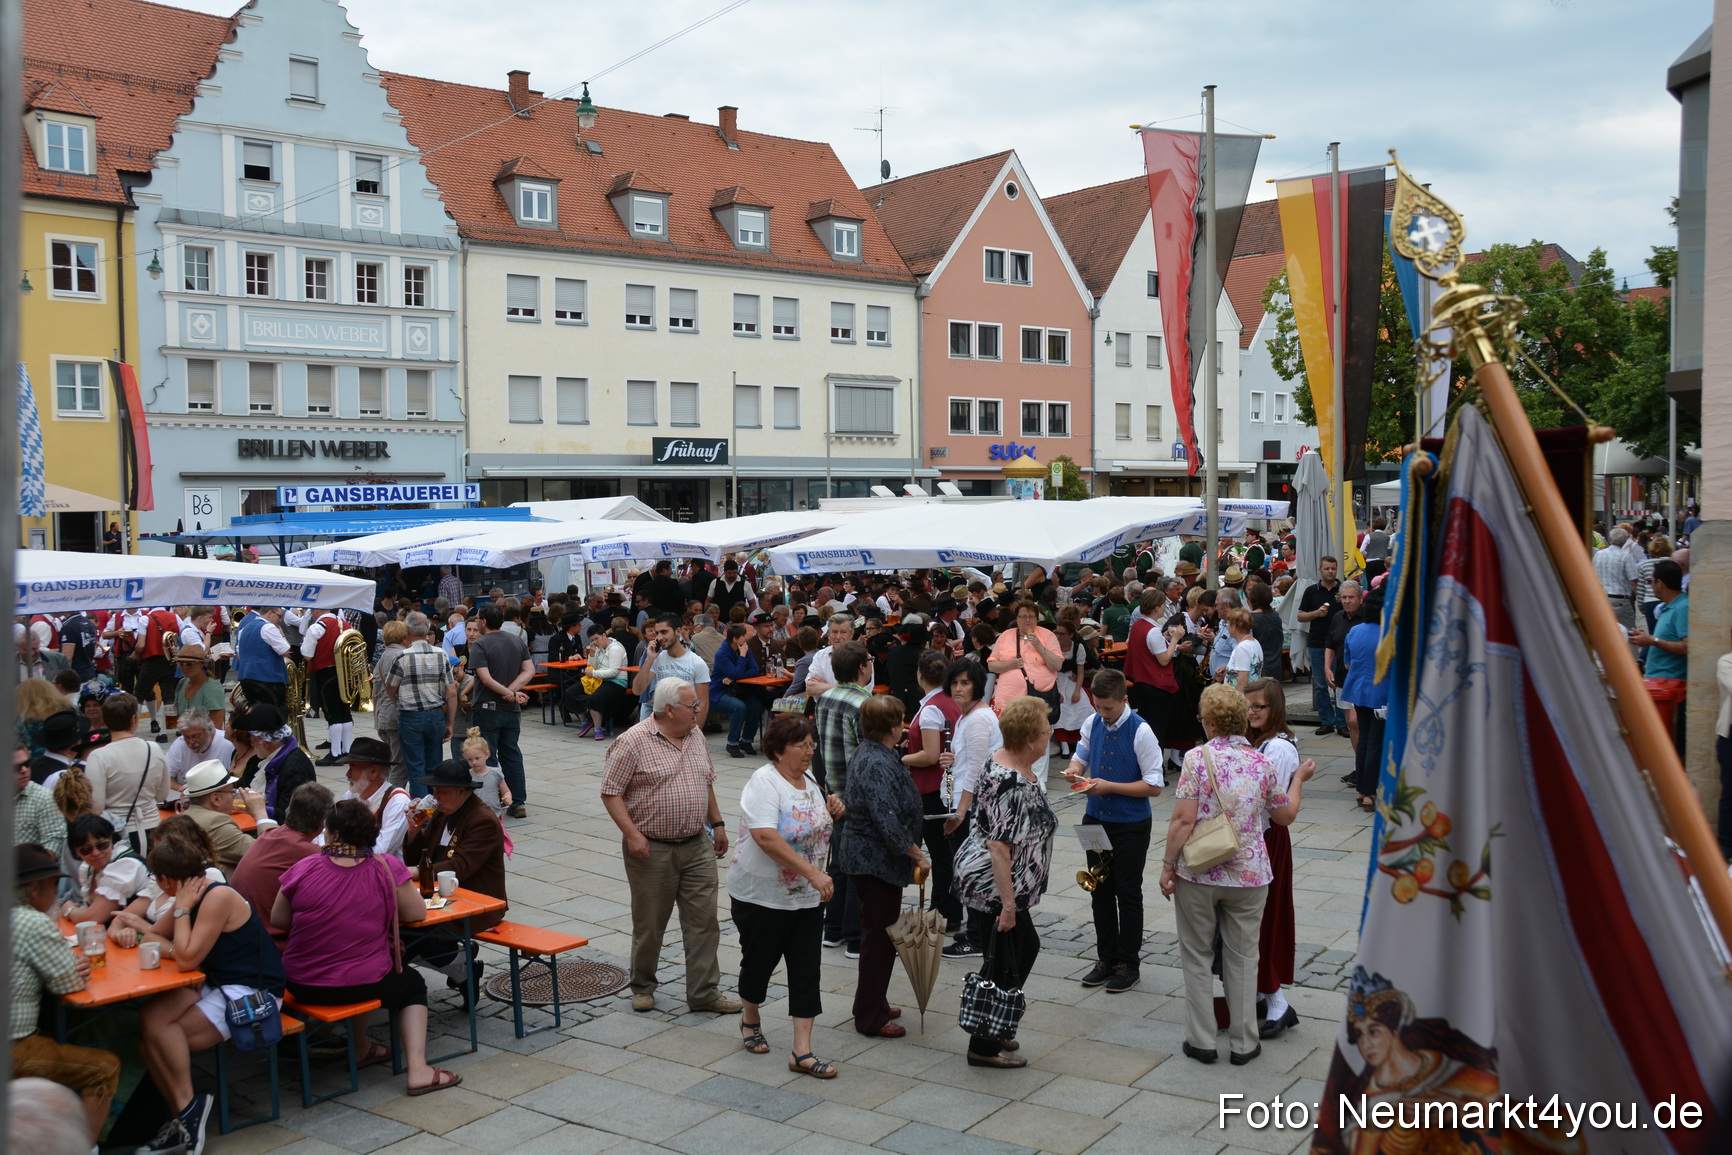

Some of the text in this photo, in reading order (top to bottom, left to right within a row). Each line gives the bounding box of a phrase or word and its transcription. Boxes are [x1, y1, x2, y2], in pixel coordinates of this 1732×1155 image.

[253, 320, 379, 343] BRILLEN WEBER
[238, 438, 391, 459] BRILLEN WEBER
[305, 485, 459, 503] GANSBRAUEREI
[31, 578, 122, 592] GANSBRÄU
[225, 579, 305, 590] GANSBRÄU
